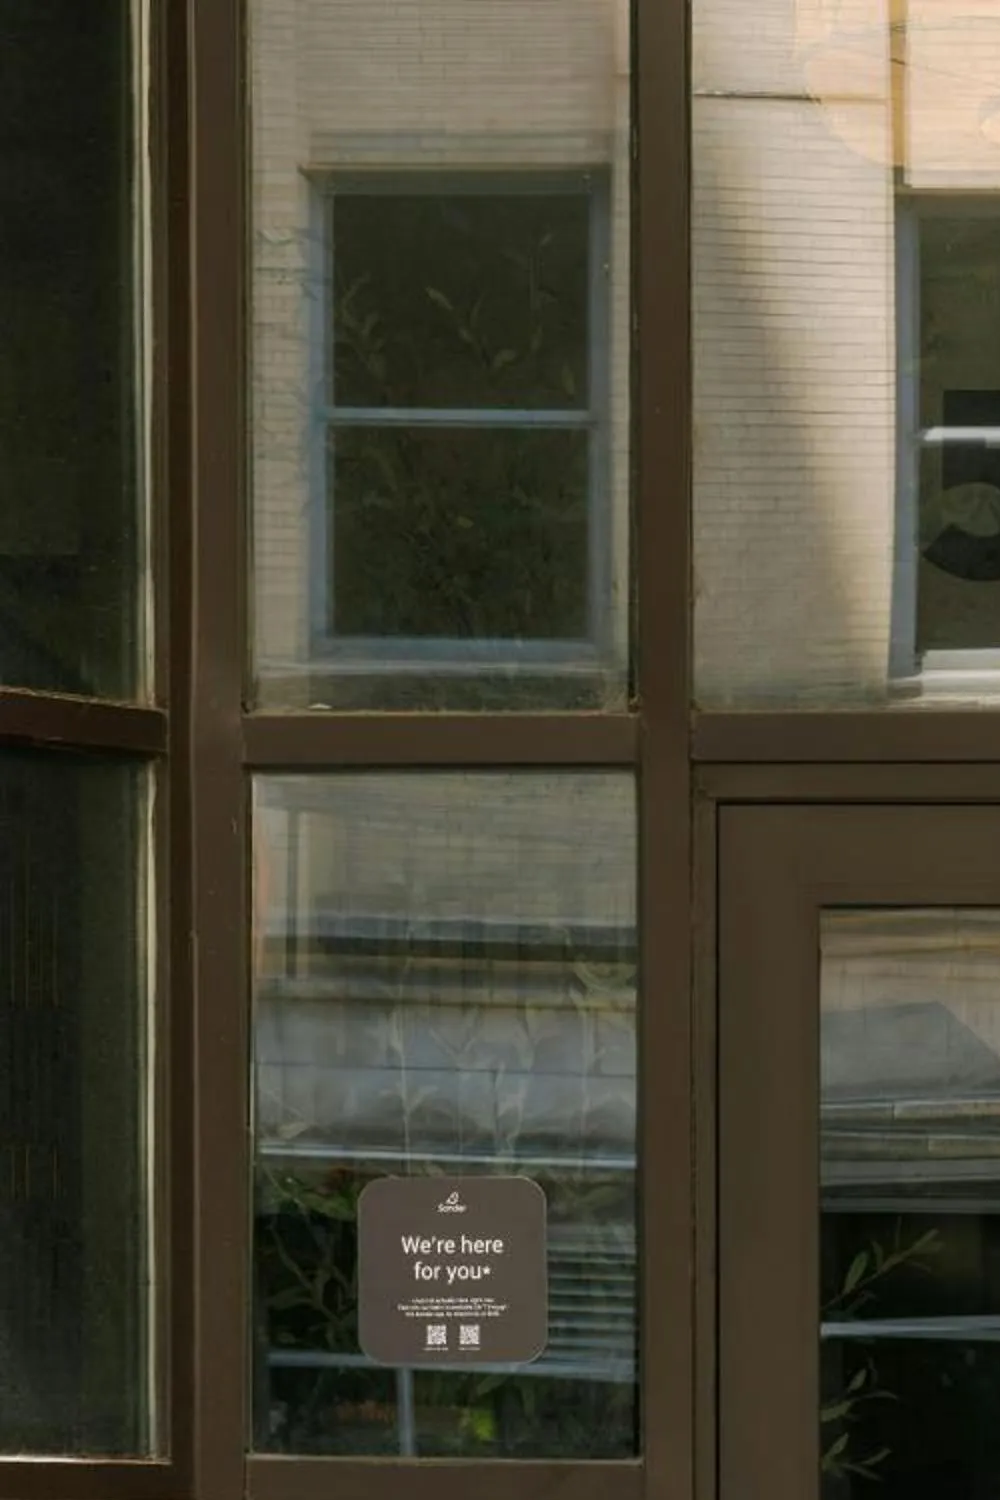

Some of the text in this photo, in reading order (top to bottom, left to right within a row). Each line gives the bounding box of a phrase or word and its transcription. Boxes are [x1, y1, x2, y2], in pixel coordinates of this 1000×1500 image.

[401, 1234, 505, 1254] We're here
[414, 1261, 442, 1280] for
